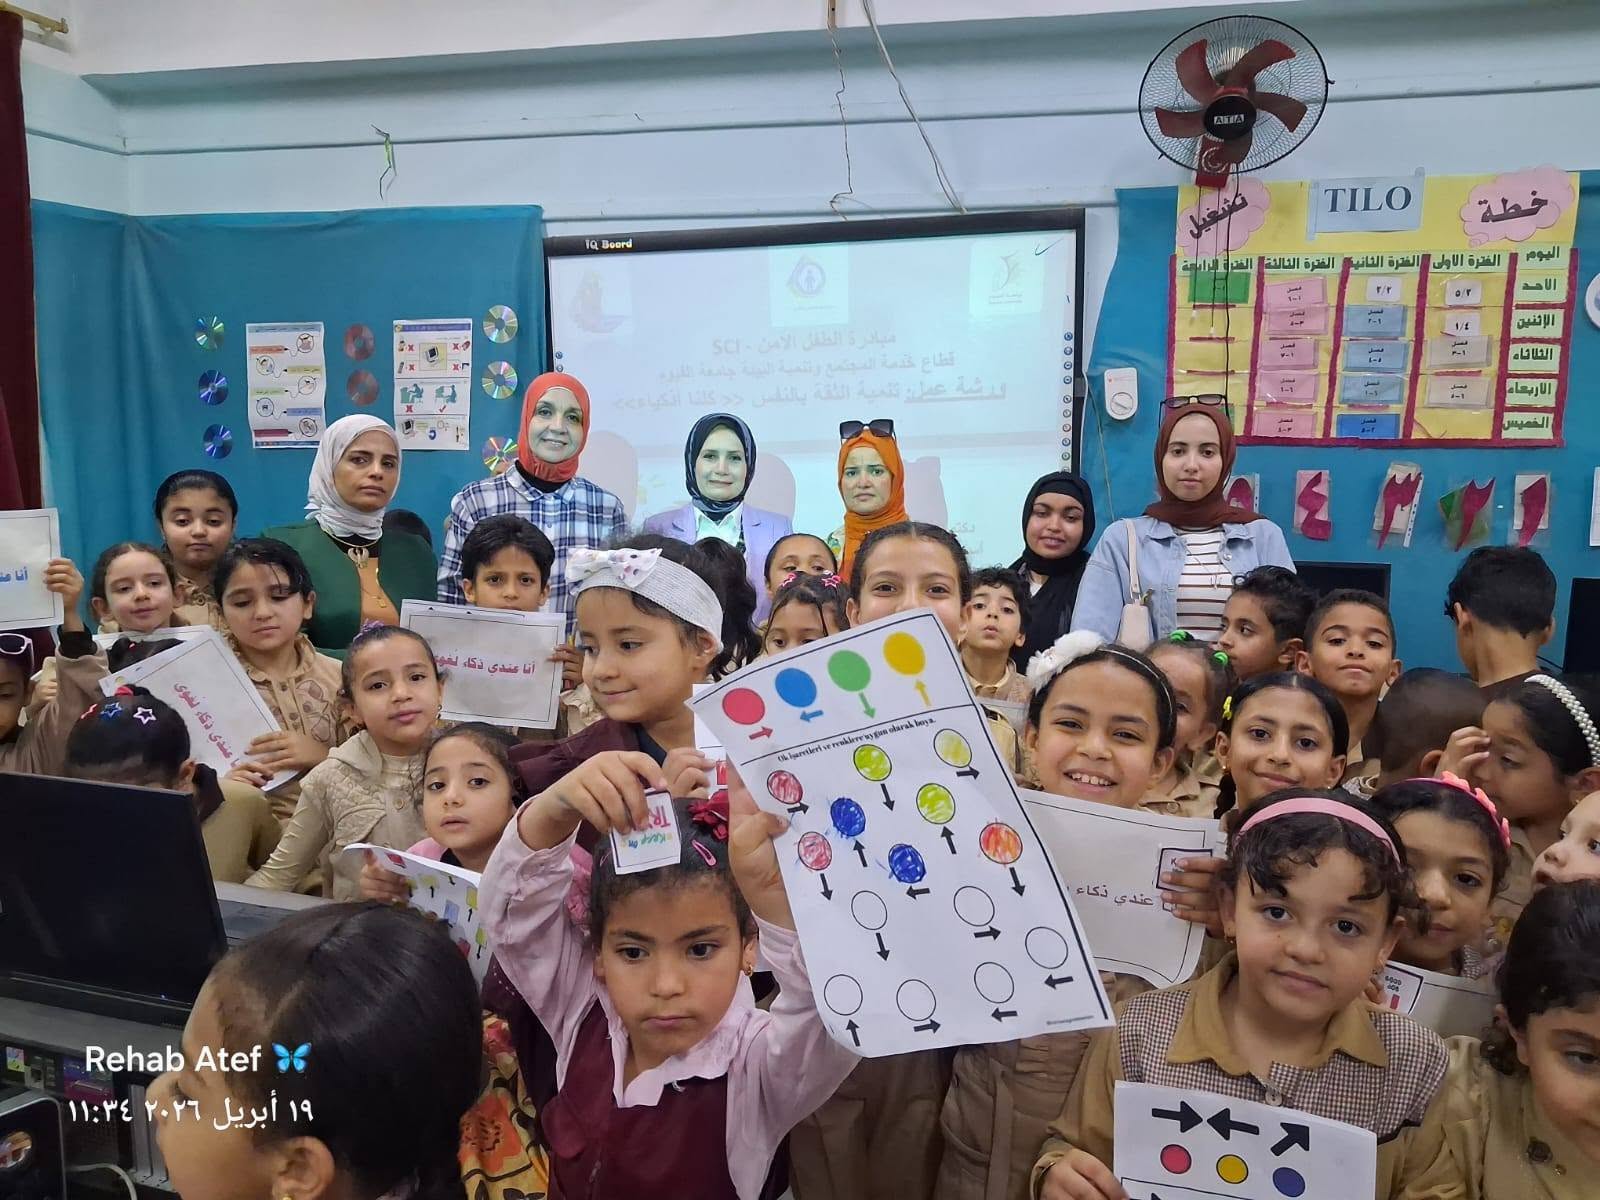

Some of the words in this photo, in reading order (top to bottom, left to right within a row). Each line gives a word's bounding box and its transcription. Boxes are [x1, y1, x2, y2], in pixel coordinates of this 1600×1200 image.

[1324, 185, 1411, 213] TILO
[1481, 190, 1548, 223] خطة
[585, 239, 599, 250] IQ
[601, 238, 633, 249] Board
[1526, 246, 1559, 261] اليوم
[1265, 257, 1299, 270] الثالثة
[1304, 256, 1334, 271] الفترة
[1389, 254, 1419, 270] الفترة
[1468, 254, 1500, 270] الفترة
[1513, 347, 1553, 360] الثلاثاء
[1502, 416, 1549, 430] الخميس
[463, 656, 484, 670] ذكاء
[487, 663, 520, 676] عندي
[523, 661, 535, 674] أنا
[889, 720, 914, 733] olarak
[1076, 884, 1108, 898] ذكاء
[1114, 893, 1154, 907] عندي
